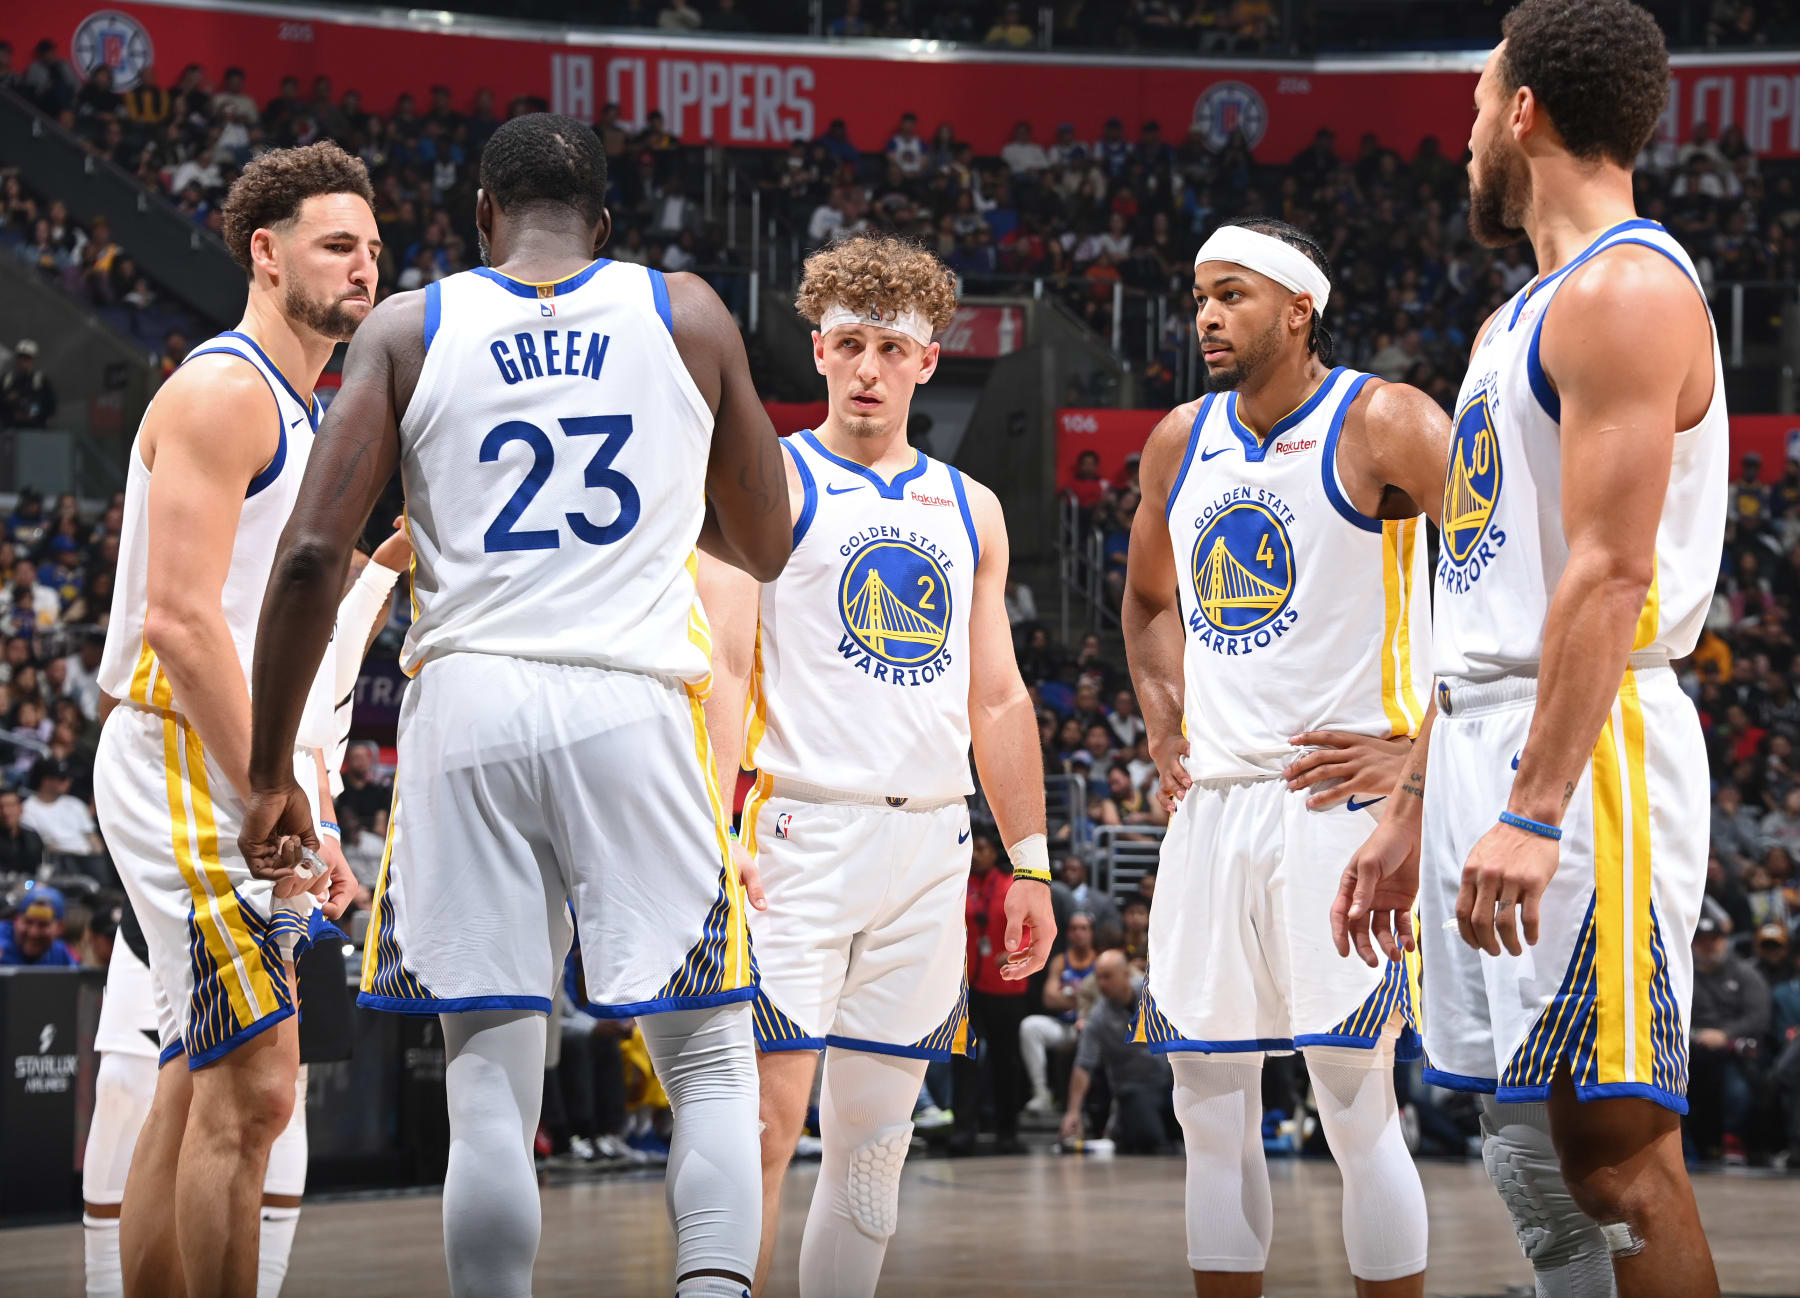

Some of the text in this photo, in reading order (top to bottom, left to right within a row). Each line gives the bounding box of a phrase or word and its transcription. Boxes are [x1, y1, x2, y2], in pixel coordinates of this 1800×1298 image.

[607, 57, 815, 141] CLIPPERS
[490, 330, 610, 385] GREEN
[1275, 438, 1317, 455] Rakuten
[479, 414, 641, 553] 23
[911, 491, 954, 508] Rakuten
[1194, 486, 1296, 530] GOLDEN STATE
[839, 525, 954, 571] GOLDEN STATE
[1255, 533, 1275, 569] 4
[1437, 523, 1507, 595] ARRIORS
[917, 575, 936, 610] 2
[1188, 606, 1299, 656] WARRIORS
[837, 633, 952, 687] WARRIORS
